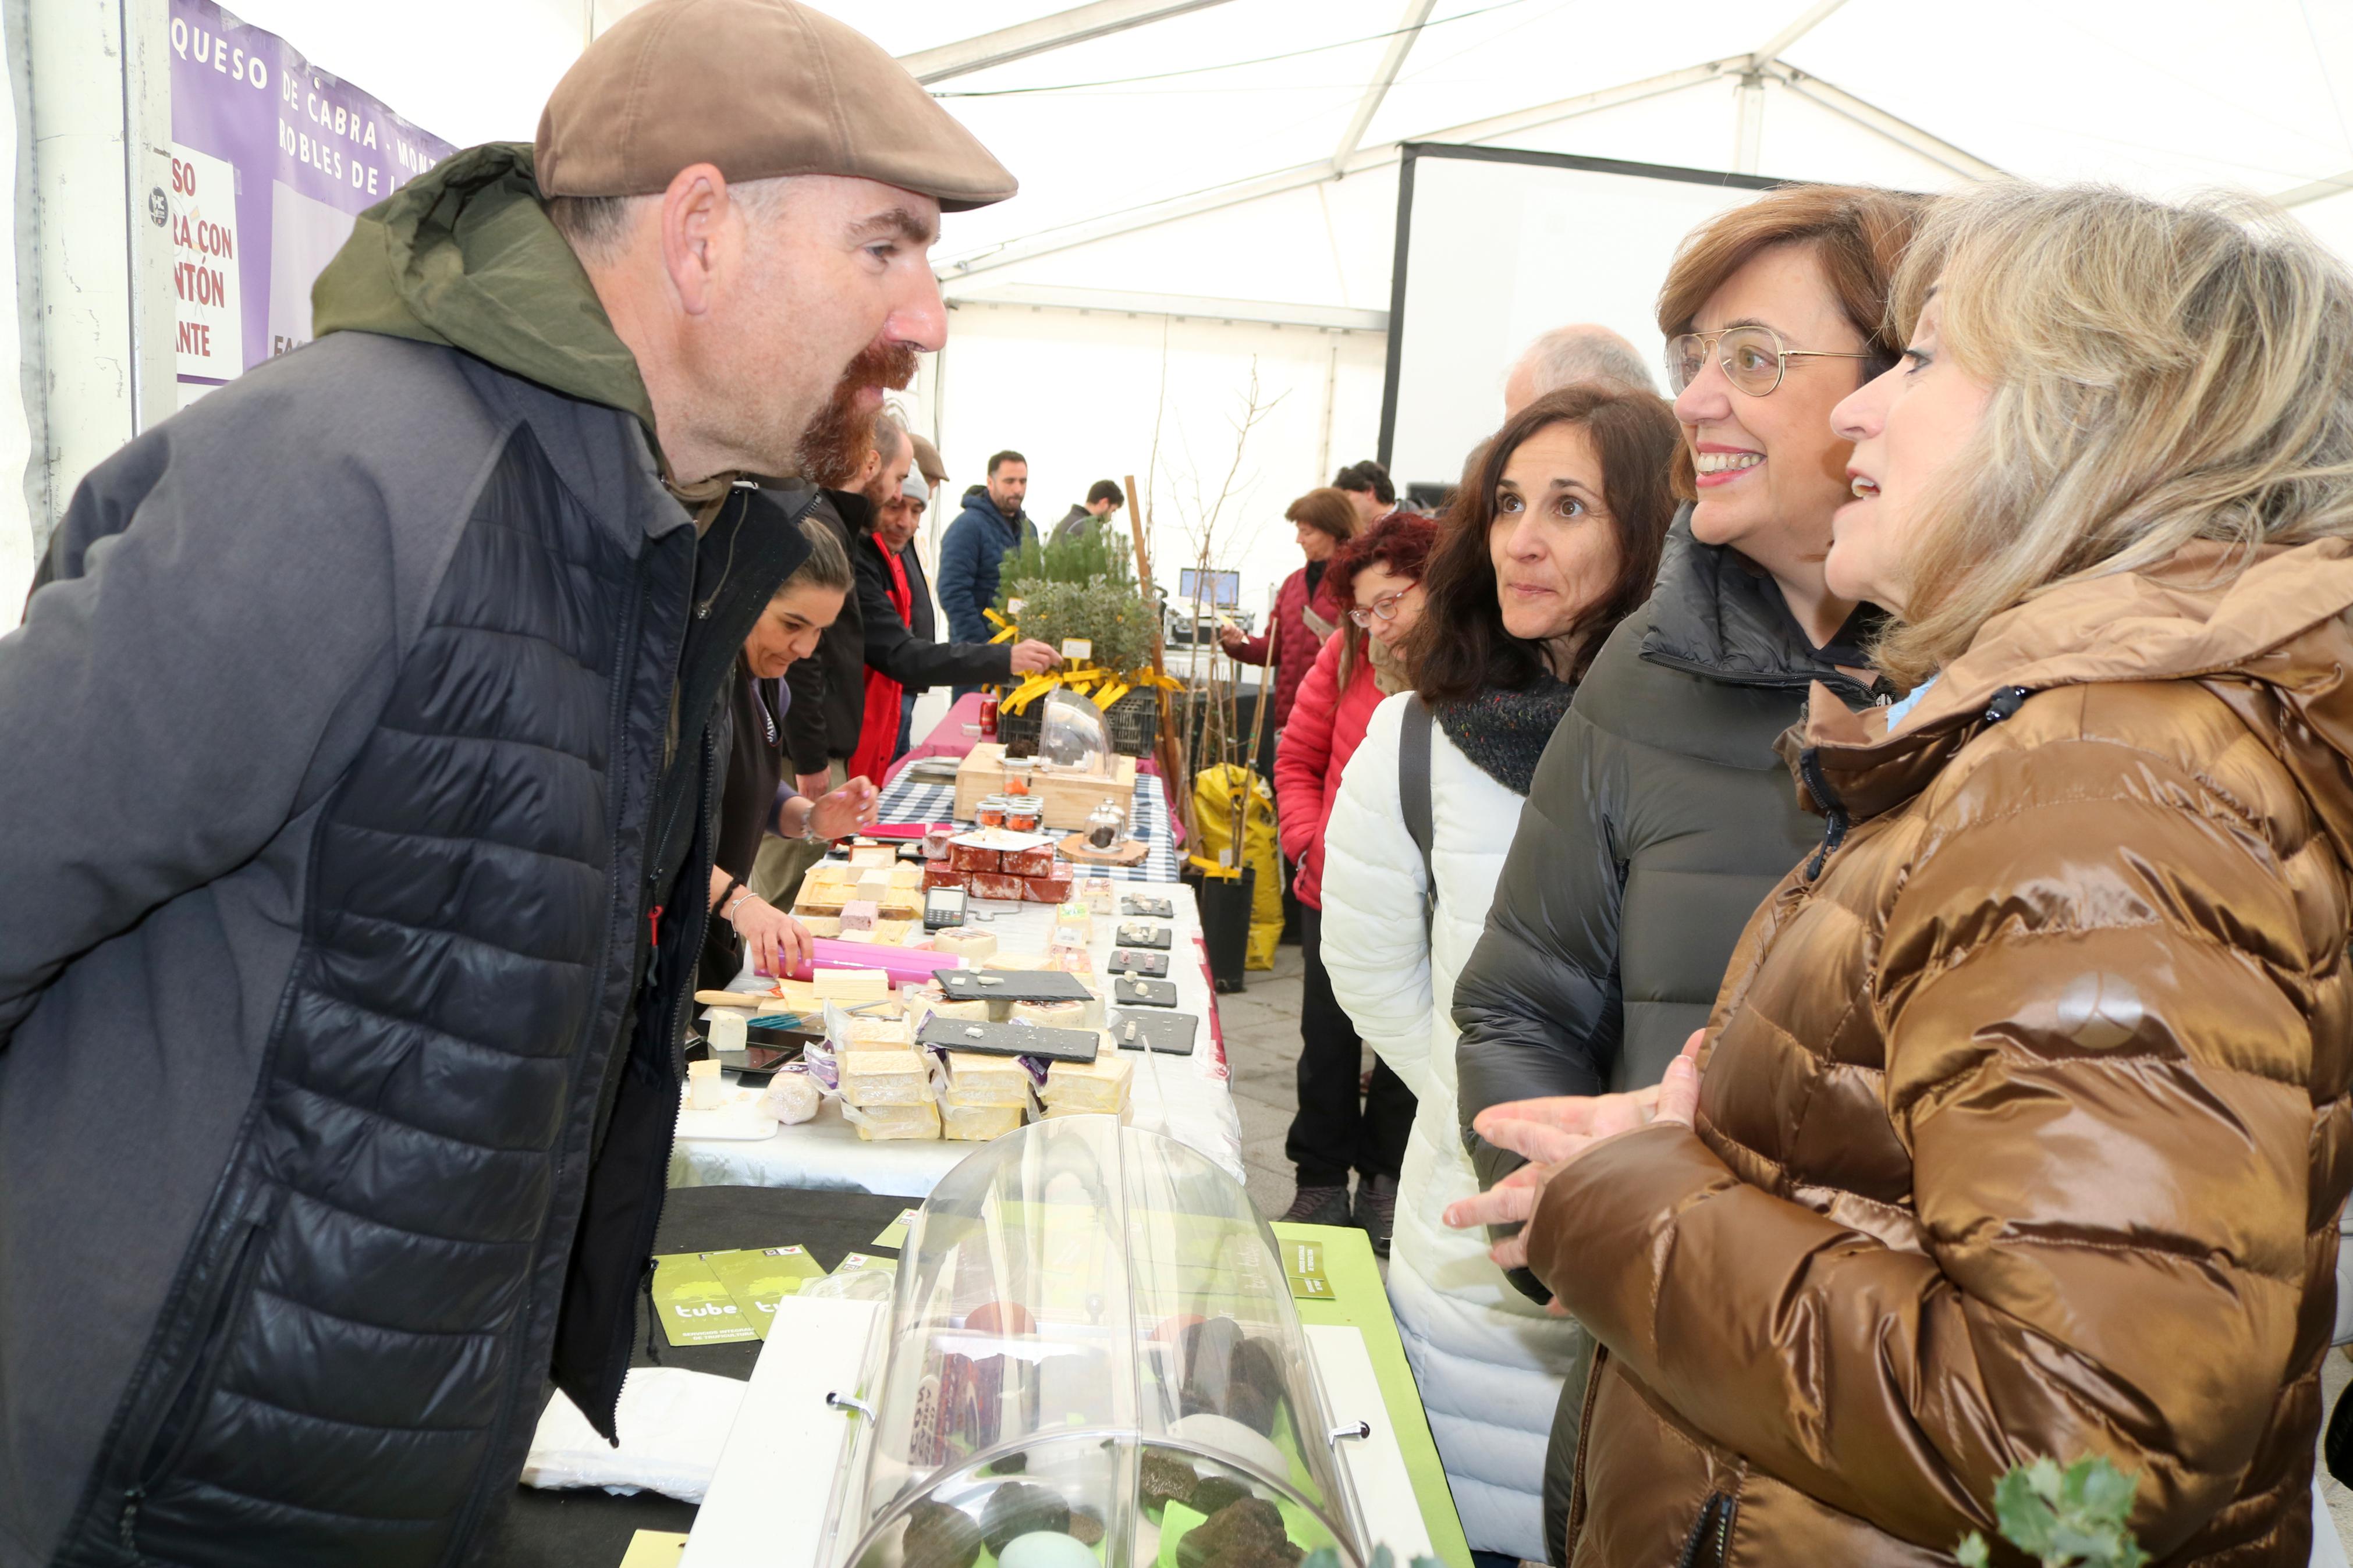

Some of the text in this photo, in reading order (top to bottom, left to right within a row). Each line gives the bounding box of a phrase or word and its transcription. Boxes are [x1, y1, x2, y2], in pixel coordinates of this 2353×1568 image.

[171, 17, 268, 89] QUESO
[283, 70, 299, 111] DE
[307, 93, 377, 150] CABRA
[279, 118, 342, 179] ROBLES
[352, 160, 378, 195] DE
[198, 220, 232, 259] CON
[175, 321, 211, 357] NTE
[675, 1303, 743, 1317] tube
